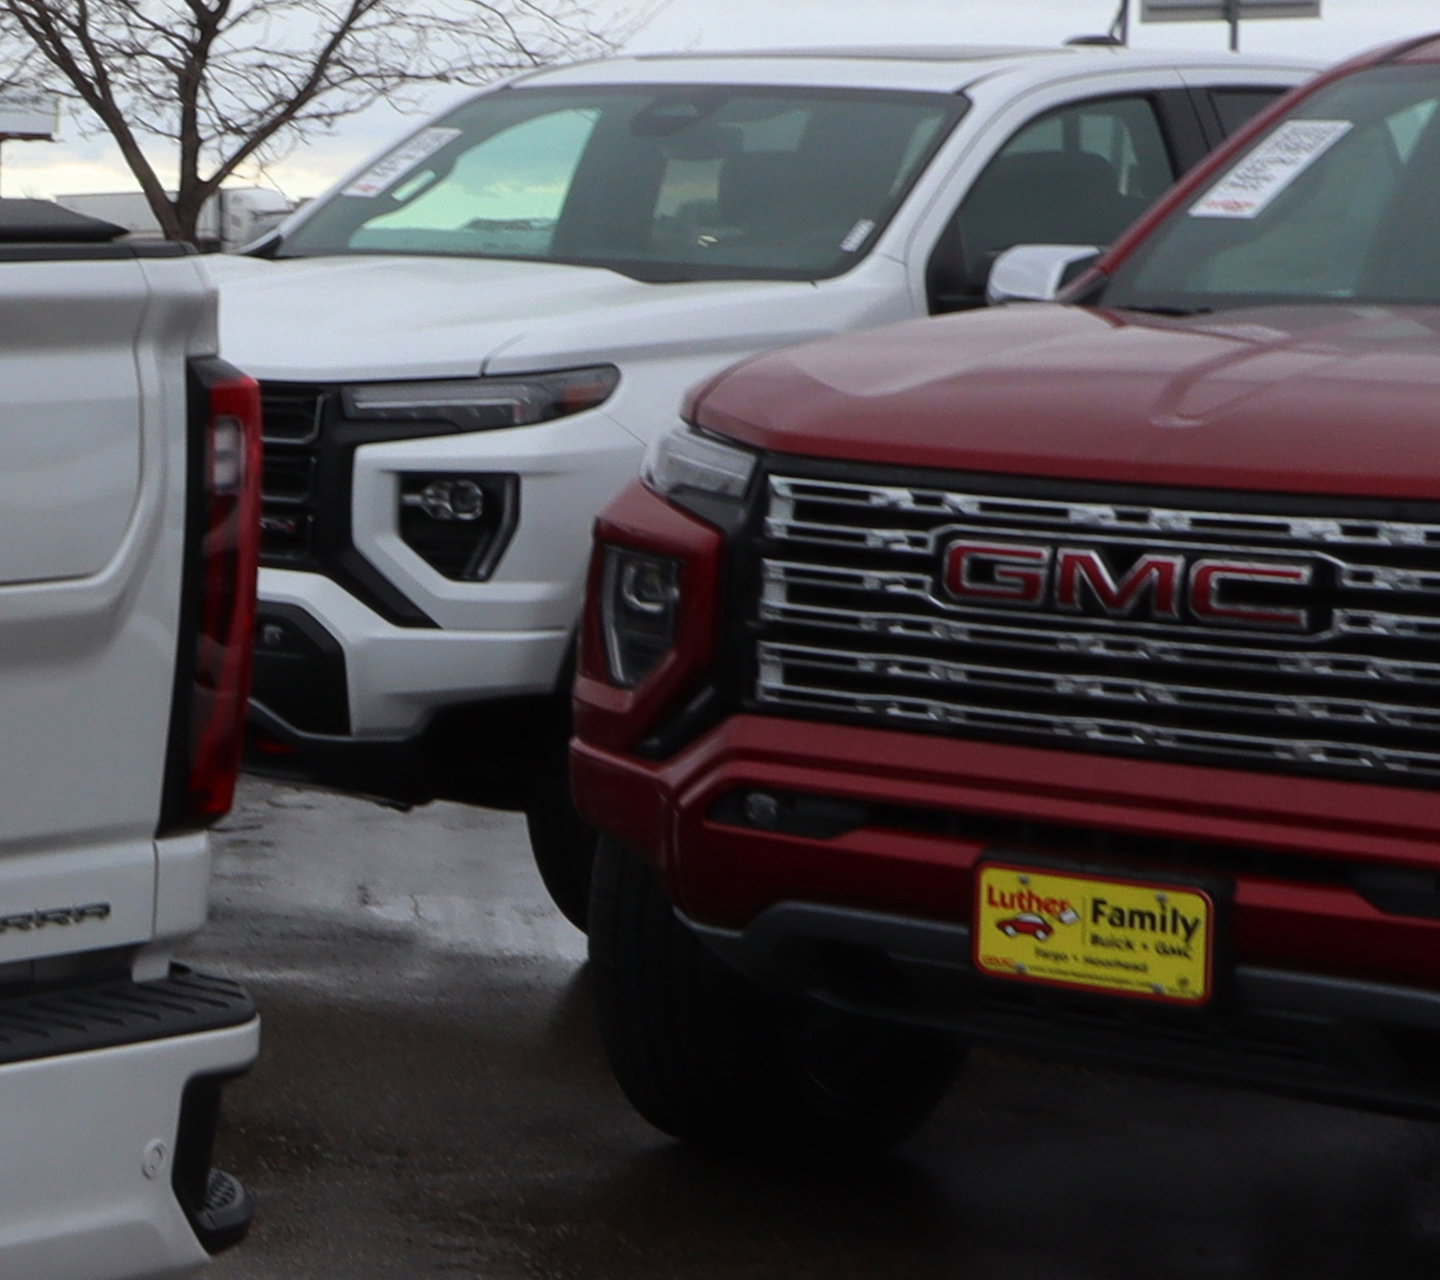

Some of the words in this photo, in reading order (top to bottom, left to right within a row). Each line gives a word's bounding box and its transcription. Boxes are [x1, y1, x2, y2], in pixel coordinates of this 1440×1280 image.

[943, 539, 1313, 631] GMC
[987, 885, 1071, 916] Luther
[1091, 898, 1200, 942] Family
